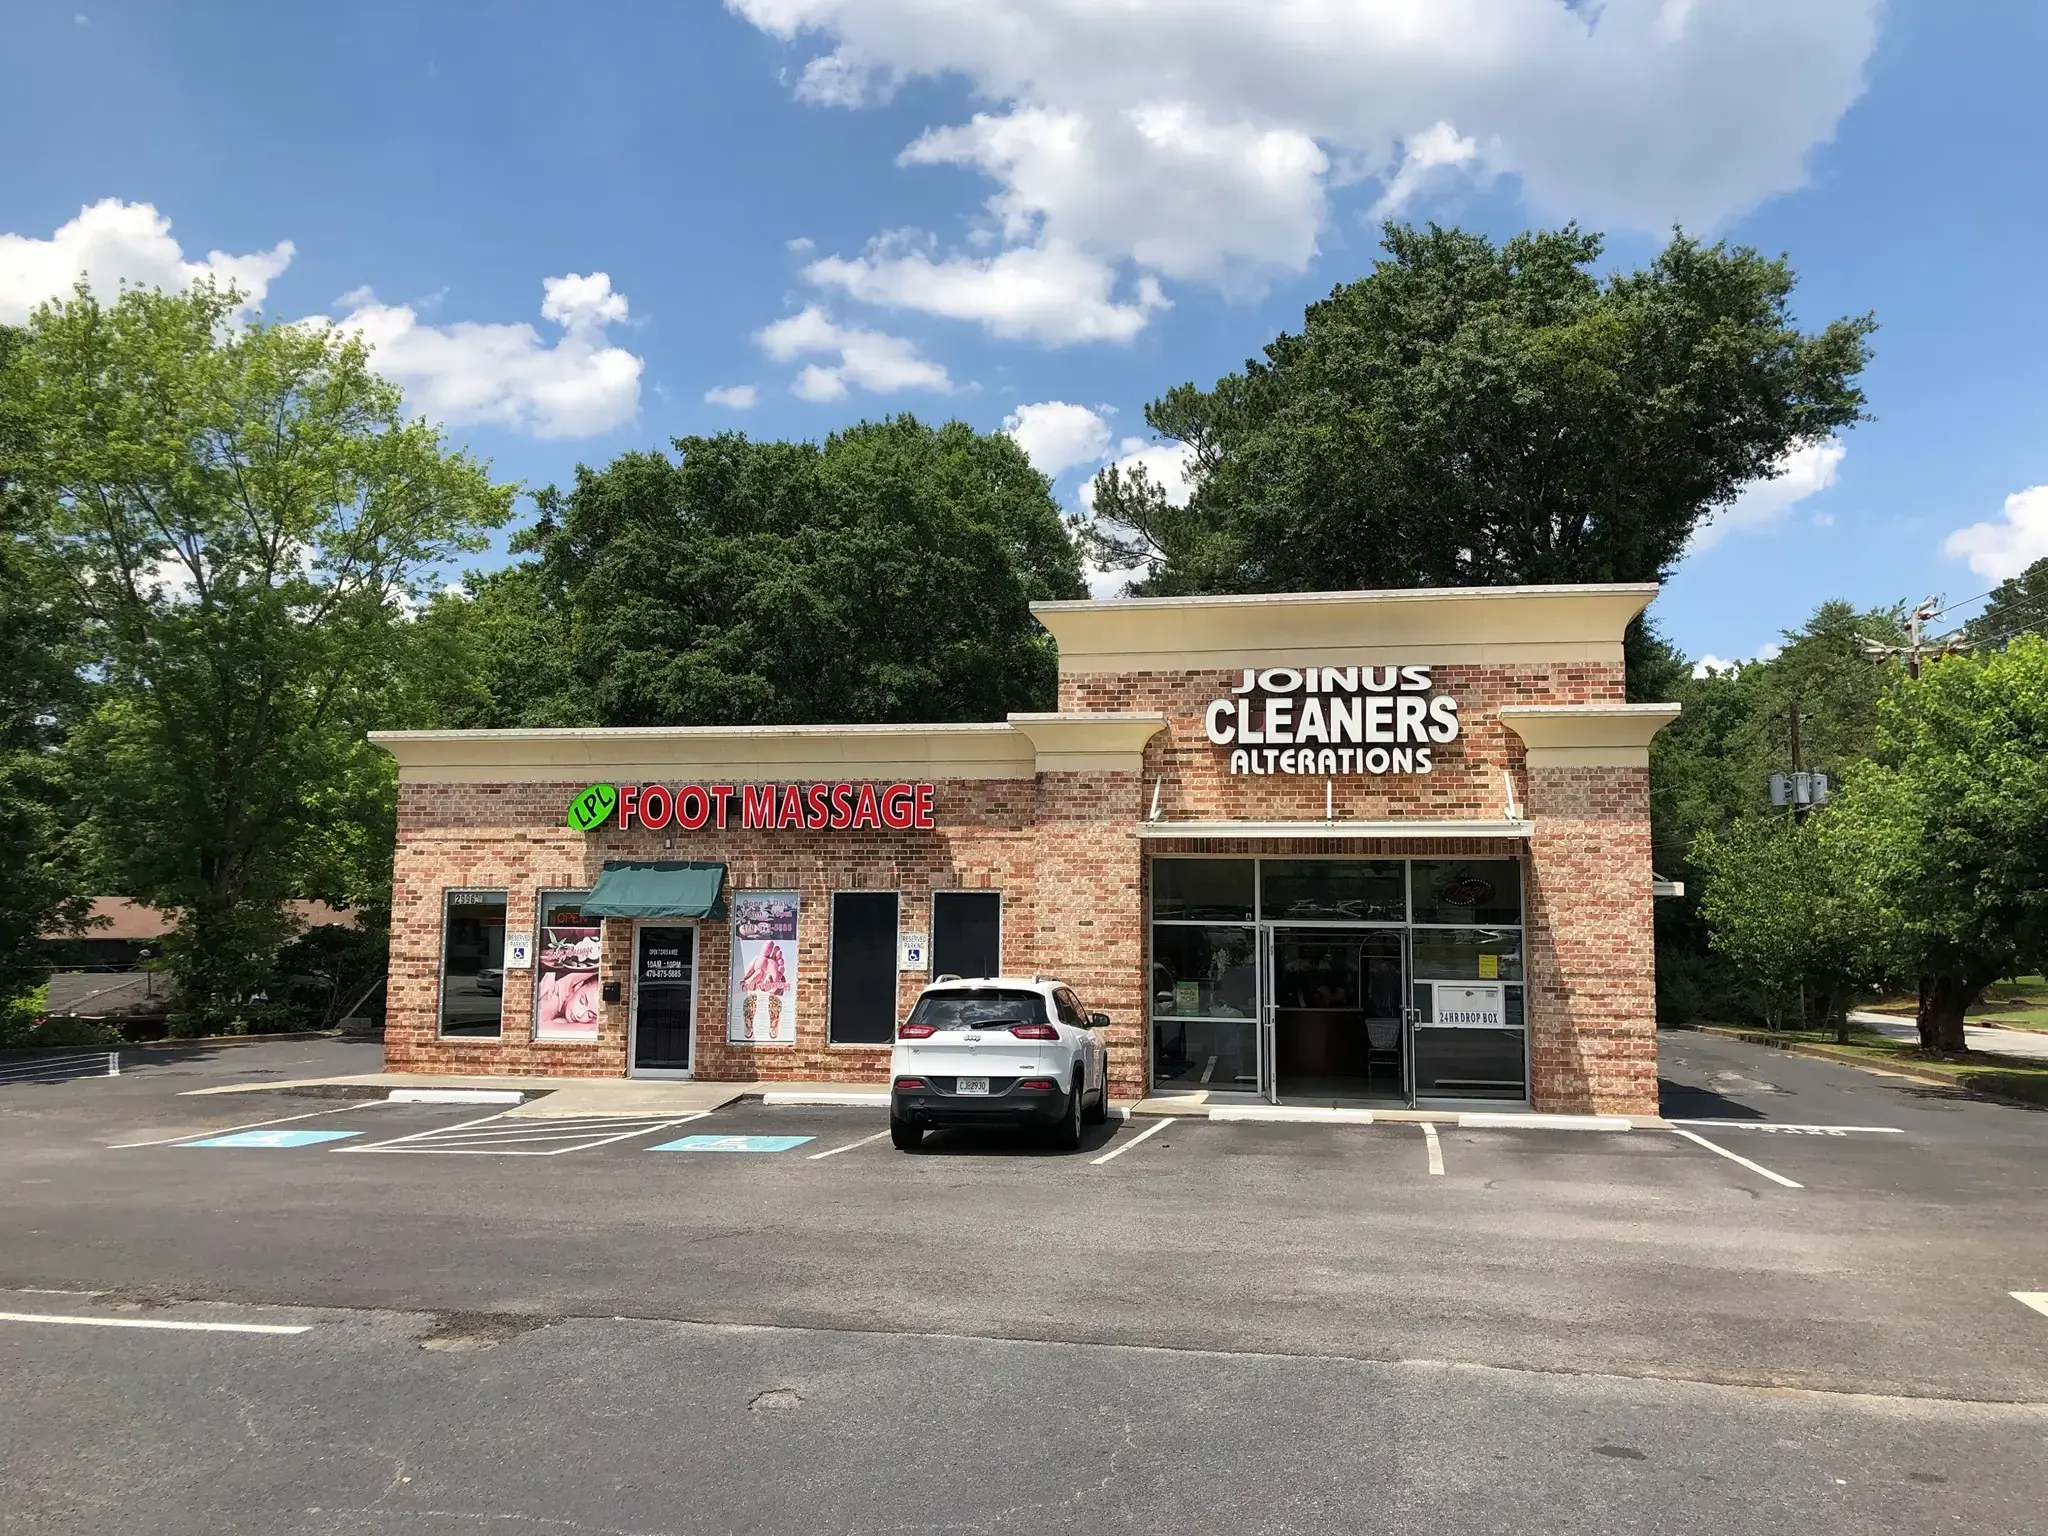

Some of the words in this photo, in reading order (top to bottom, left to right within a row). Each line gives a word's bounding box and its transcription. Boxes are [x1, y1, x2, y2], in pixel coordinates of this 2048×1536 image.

[1231, 665, 1433, 694] JOINUS
[1205, 695, 1459, 745] CLEANERS
[1230, 747, 1433, 775] ALTERATIONS
[573, 787, 614, 828] LPL
[619, 785, 734, 830] FOOT
[742, 783, 935, 830] MASSAGE
[1460, 1012, 1481, 1023] DROP
[1482, 1012, 1498, 1023] BOX
